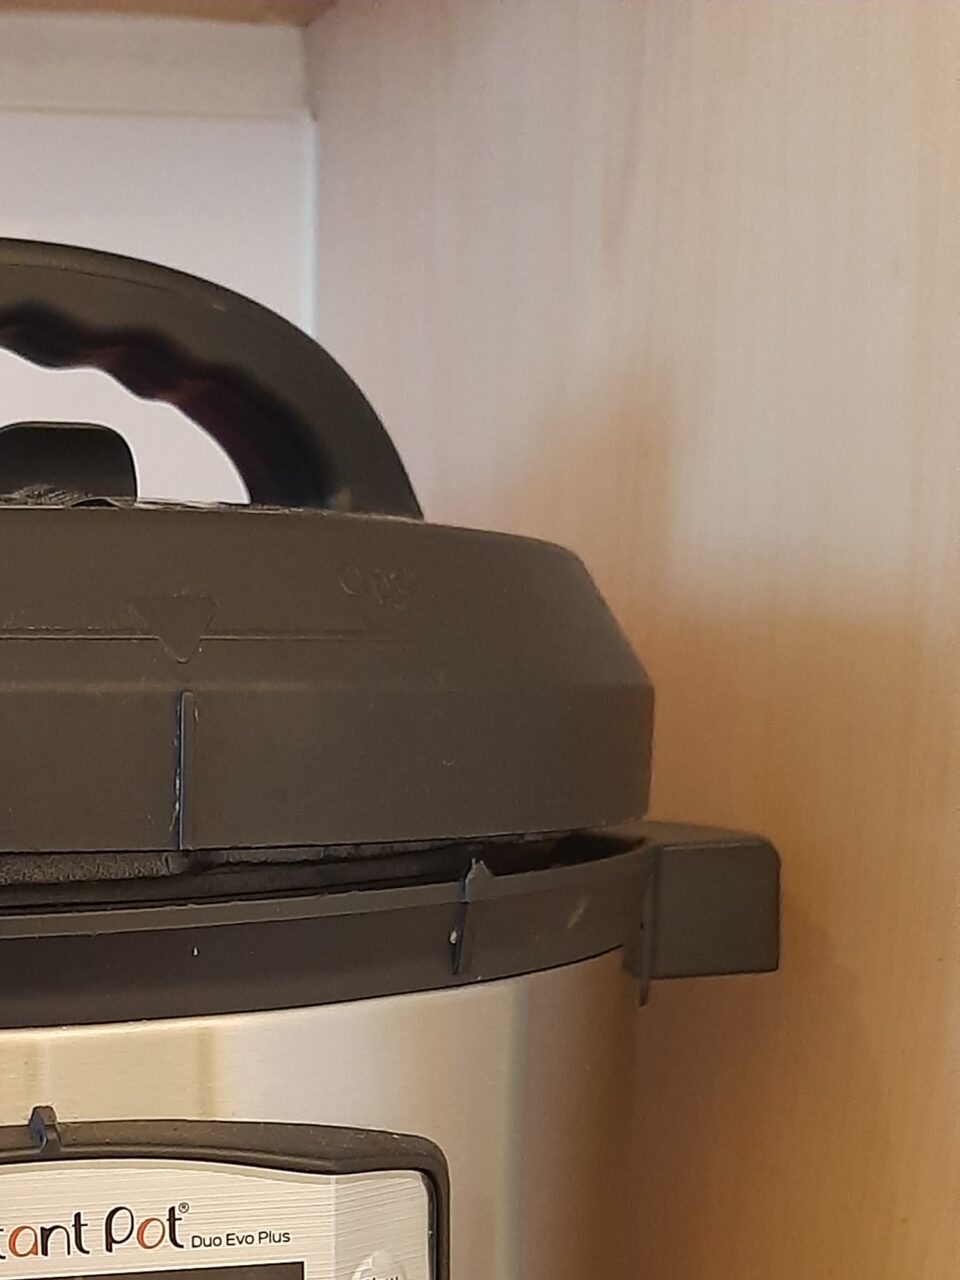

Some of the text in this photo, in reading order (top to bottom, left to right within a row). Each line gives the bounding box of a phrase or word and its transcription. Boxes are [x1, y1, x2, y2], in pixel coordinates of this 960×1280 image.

[191, 1230, 291, 1248] Duo Evo Plus
